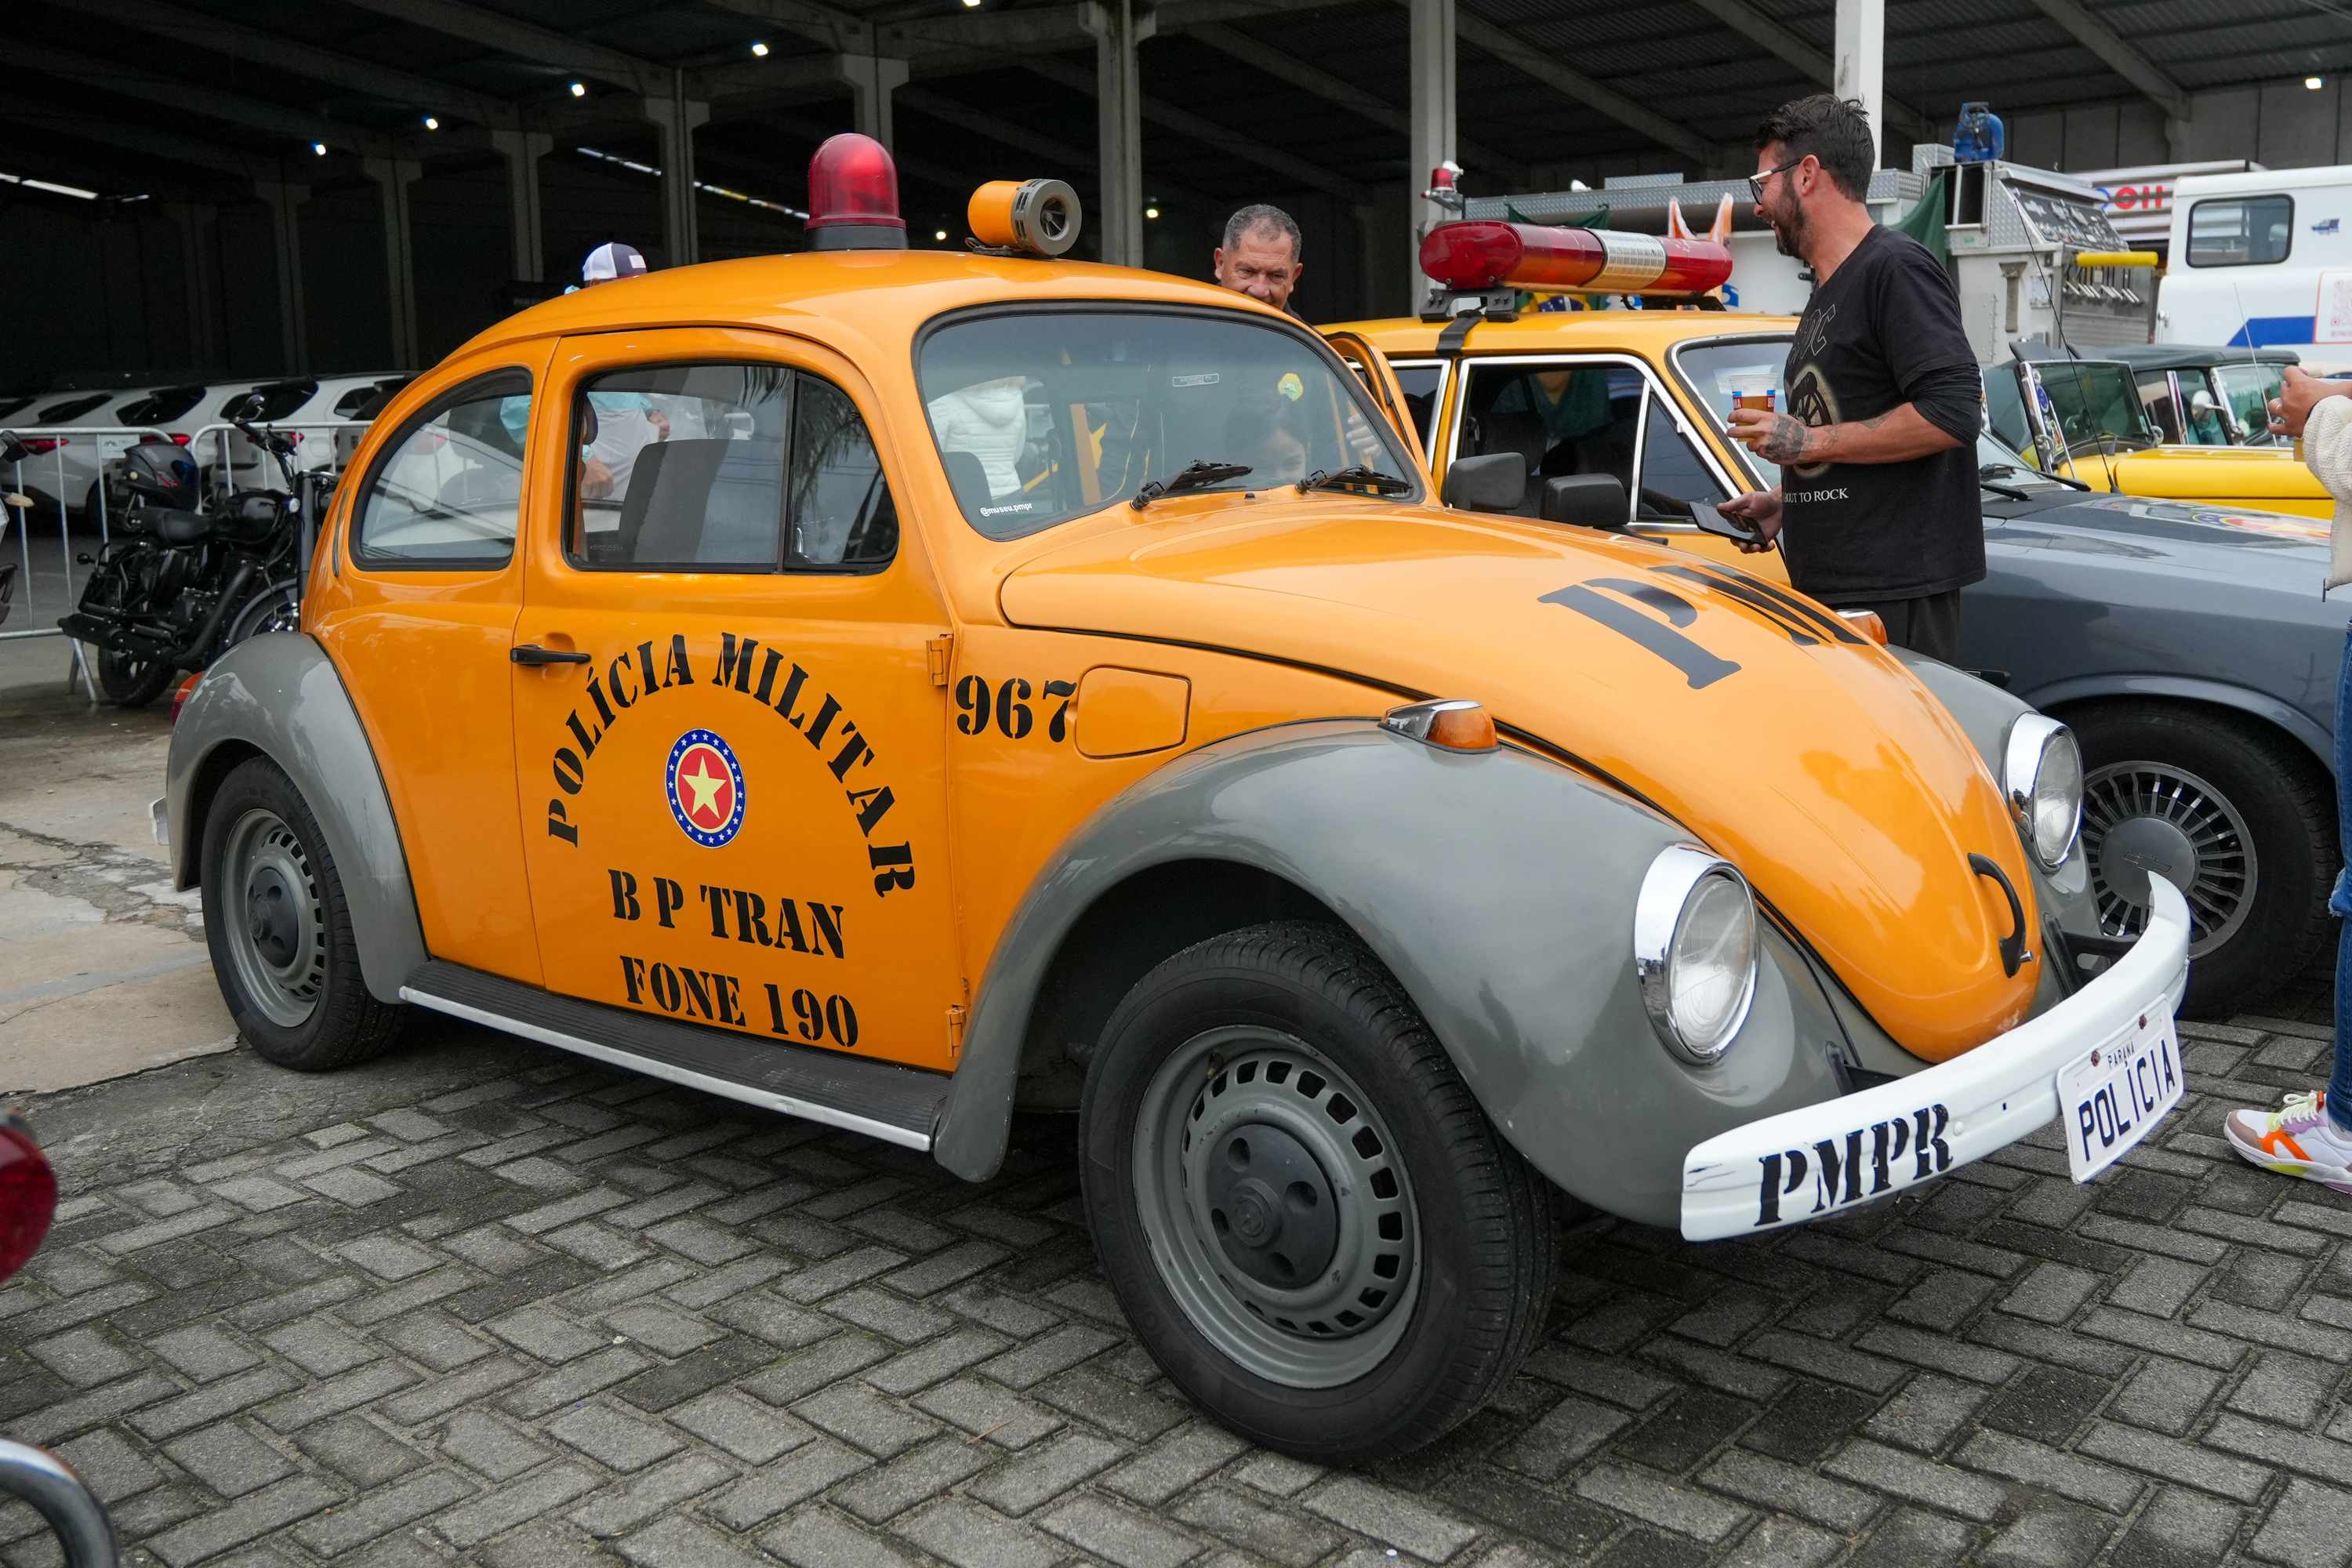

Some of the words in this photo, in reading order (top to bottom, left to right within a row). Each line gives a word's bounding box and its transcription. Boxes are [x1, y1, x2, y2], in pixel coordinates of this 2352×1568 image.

[980, 503, 1033, 517] @museu.pmpr
[1798, 492, 1812, 503] TO
[1813, 488, 1849, 502] ROCK
[955, 674, 1077, 743] 967
[548, 633, 695, 848] POLÍCIA
[711, 631, 916, 898] MILITAR
[608, 869, 641, 921] B
[653, 877, 684, 929] P
[699, 884, 845, 960] TRAN
[619, 955, 747, 1027] FONE
[763, 983, 859, 1048] 190
[2107, 1036, 2136, 1070] PARANÁ
[2078, 1038, 2176, 1163] POLÍCIA
[1753, 1103, 1954, 1227] PMPR
